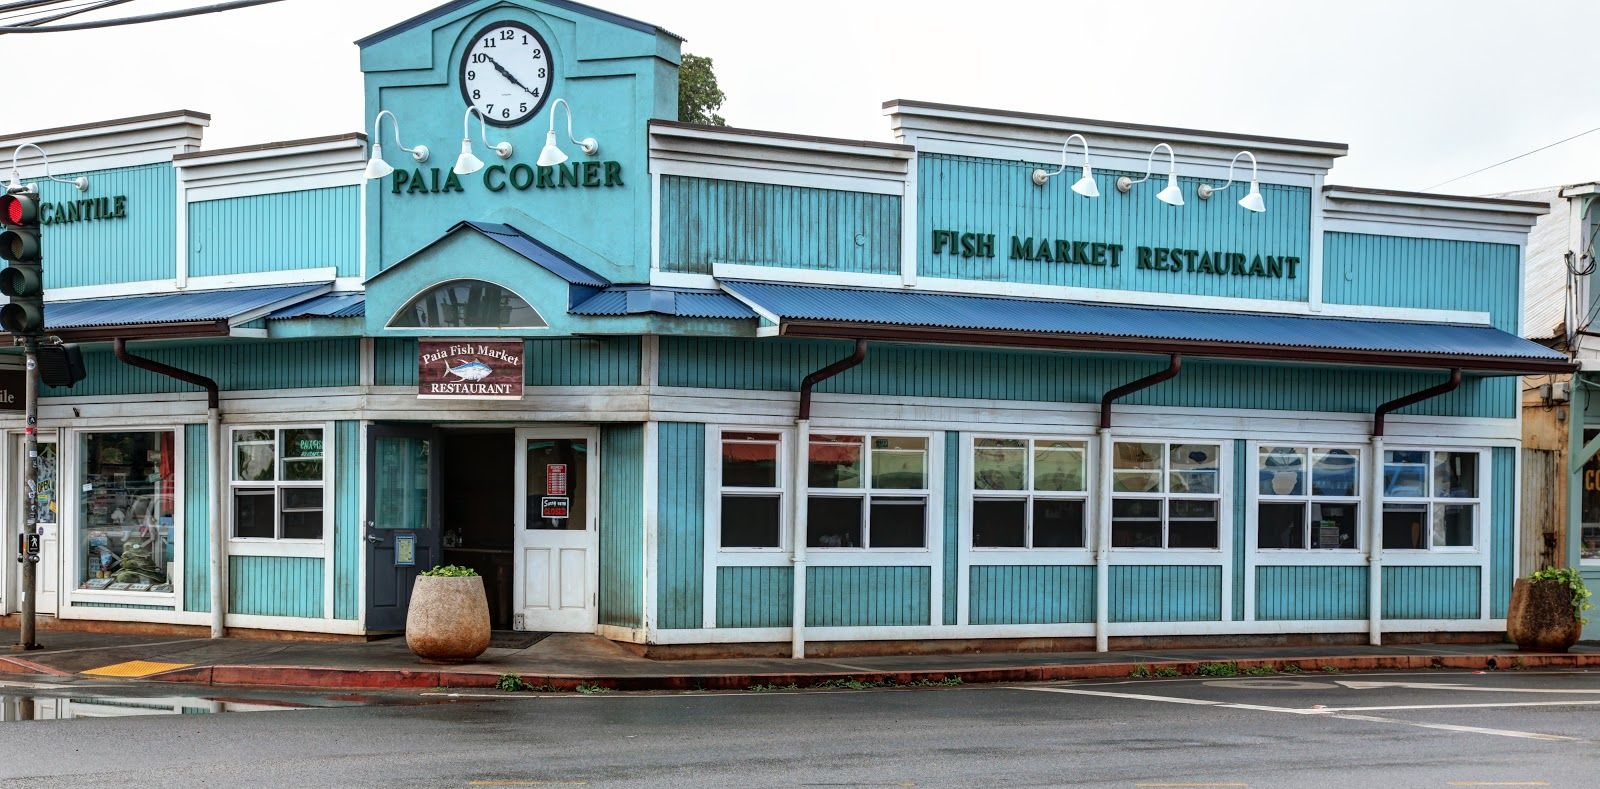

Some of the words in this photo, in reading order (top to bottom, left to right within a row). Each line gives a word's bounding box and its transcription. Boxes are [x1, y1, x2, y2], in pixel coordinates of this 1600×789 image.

[500, 30, 514, 40] 12
[522, 35, 528, 45] 1
[483, 37, 496, 48] 11
[472, 53, 486, 63] 10
[533, 48, 541, 59] 2
[467, 70, 476, 80] 9
[538, 68, 546, 78] 3
[473, 89, 481, 99] 8
[531, 87, 539, 97] 4
[486, 104, 494, 114] 7
[520, 102, 527, 112] 5
[502, 108, 510, 118] 6
[391, 166, 464, 194] PAIA
[483, 160, 624, 192] CORNER
[39, 194, 127, 226] CANTILE
[933, 229, 996, 258] FISH
[1010, 235, 1123, 268] MARKET
[1136, 245, 1300, 279] RESTAURANT
[422, 349, 448, 365] Paia
[449, 343, 475, 356] Fish
[477, 344, 520, 366] Market
[431, 383, 512, 394] RESTAURANT
